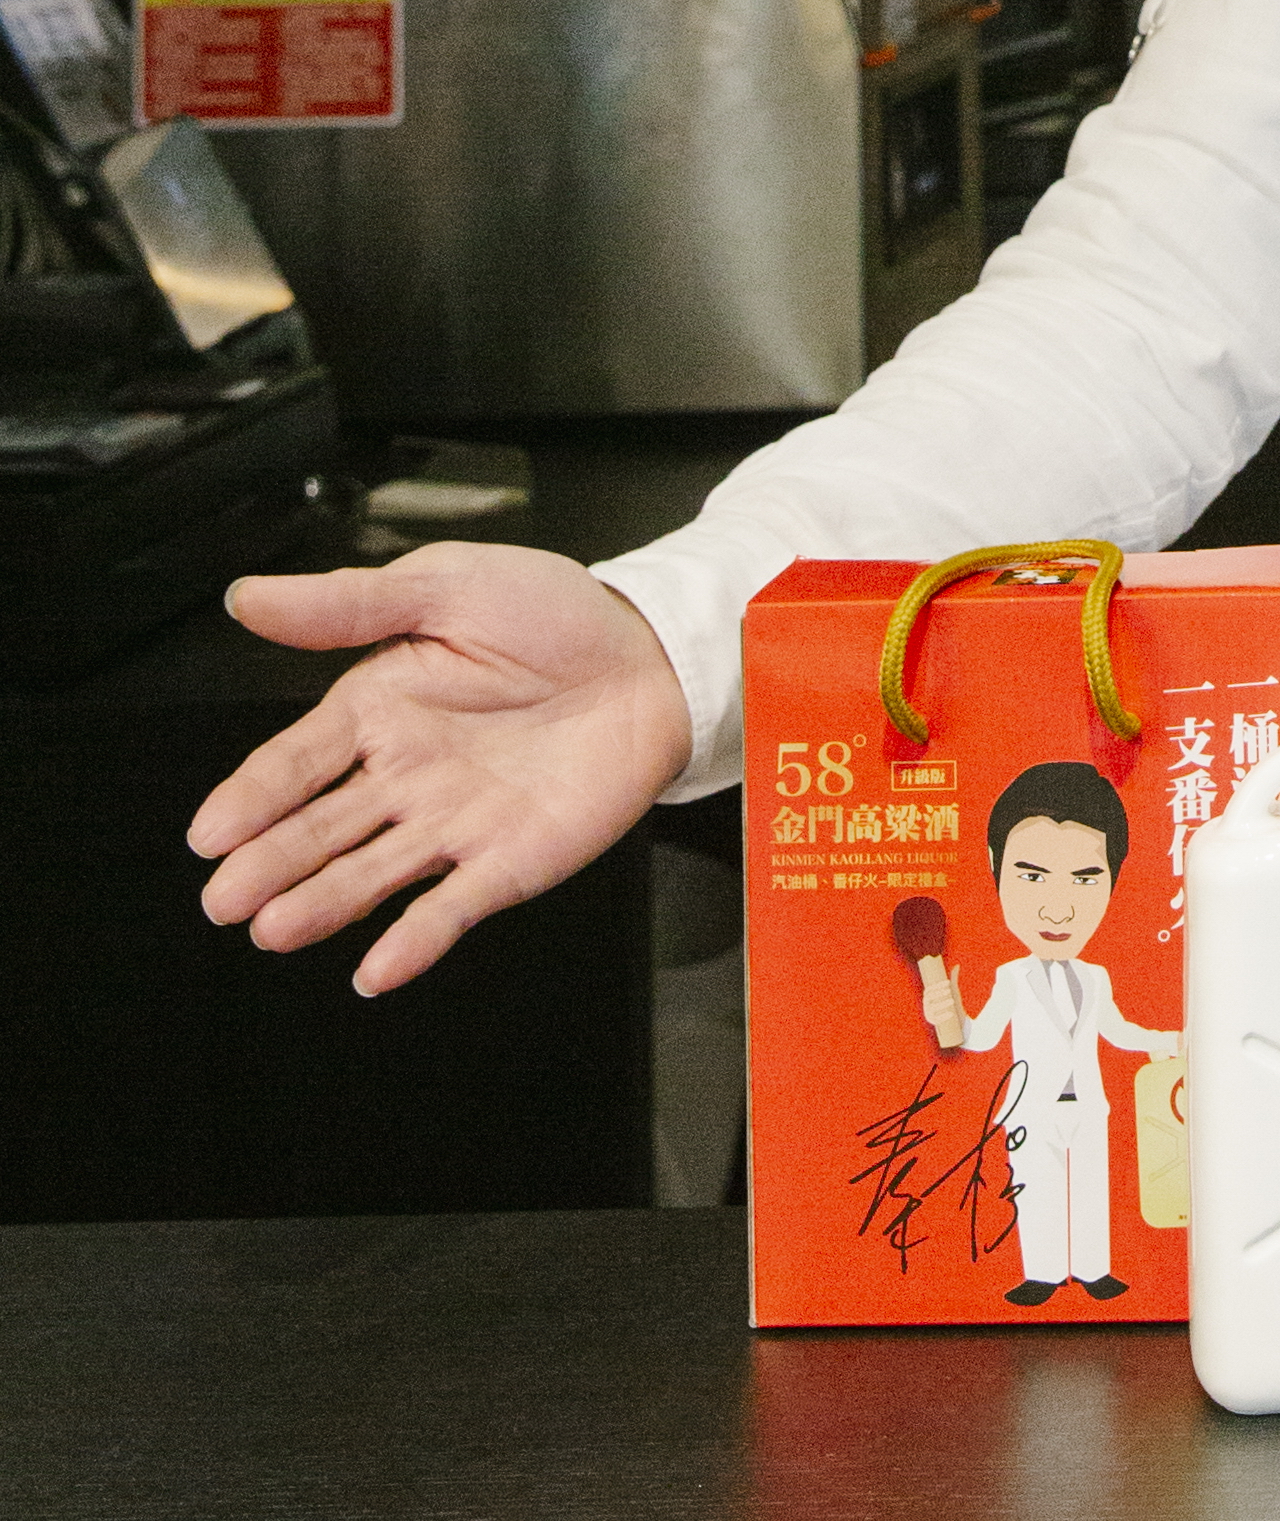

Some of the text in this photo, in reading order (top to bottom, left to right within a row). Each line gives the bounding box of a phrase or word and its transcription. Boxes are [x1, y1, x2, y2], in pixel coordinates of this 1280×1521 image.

[900, 767, 946, 785] 升級版
[771, 854, 826, 866] KINMEN
[907, 852, 958, 864] LIQUOR
